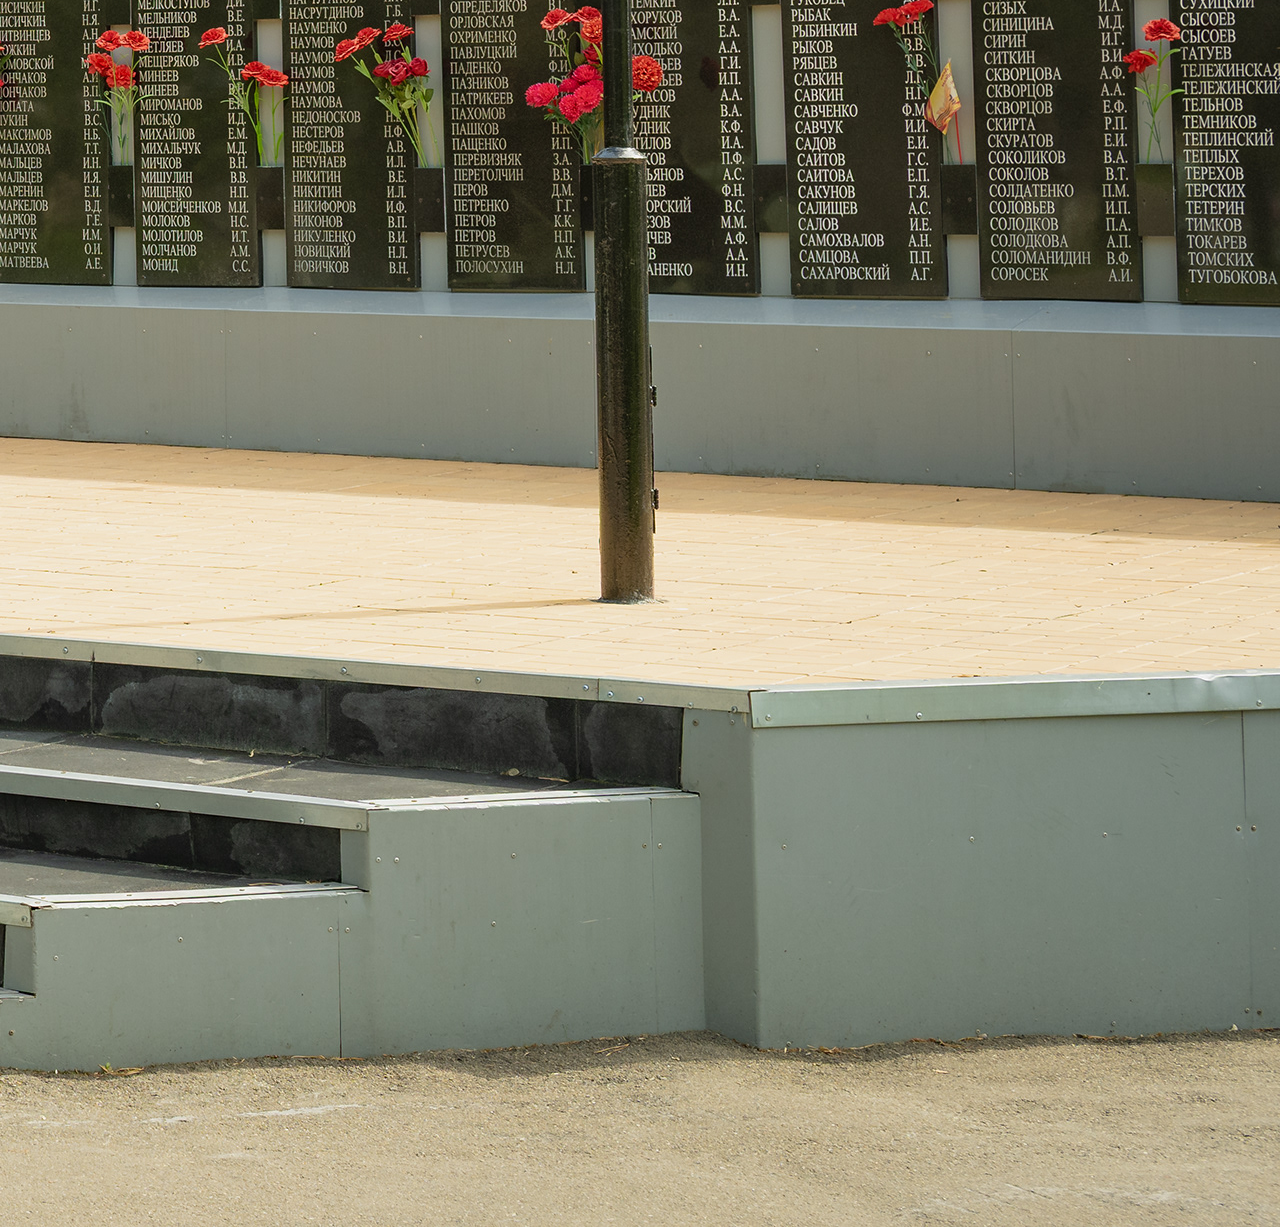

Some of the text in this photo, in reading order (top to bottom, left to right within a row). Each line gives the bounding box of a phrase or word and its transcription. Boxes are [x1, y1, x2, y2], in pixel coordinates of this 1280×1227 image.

[982, 15, 1125, 33] СИНИЦИНА М.Д.
[1181, 97, 1244, 112] ТЕЛЬНОВ
[719, 120, 744, 133] К.Ф.
[1181, 115, 1258, 129] ТЕМНИКОВ
[291, 140, 407, 155] НЕФЕДЬЕВ А.В.
[987, 150, 1129, 164] СОКОЛИКОВ В.А.
[1183, 166, 1245, 180] ТЕРЕХОВ
[797, 185, 931, 199] САКУНОВ Г.Я.
[142, 229, 250, 242] МОЛОТИЛОВ И.Т.
[799, 233, 932, 247] САМОХВАЛОВ А.Н.
[83, 243, 103, 255] О.И.
[141, 244, 251, 257] МОЛЧАНОВ А.М.
[454, 244, 576, 258] ПЕТРУСЕВ А.К.
[85, 257, 104, 269] А.Е.
[1186, 252, 1255, 267] ТОМСКИХ
[293, 260, 409, 274] НОВИЧКОВ В.Н.
[455, 260, 577, 274] ПОЛОСУХИН Н.Л.
[990, 267, 1134, 282] СОРОСЕК А.И.
